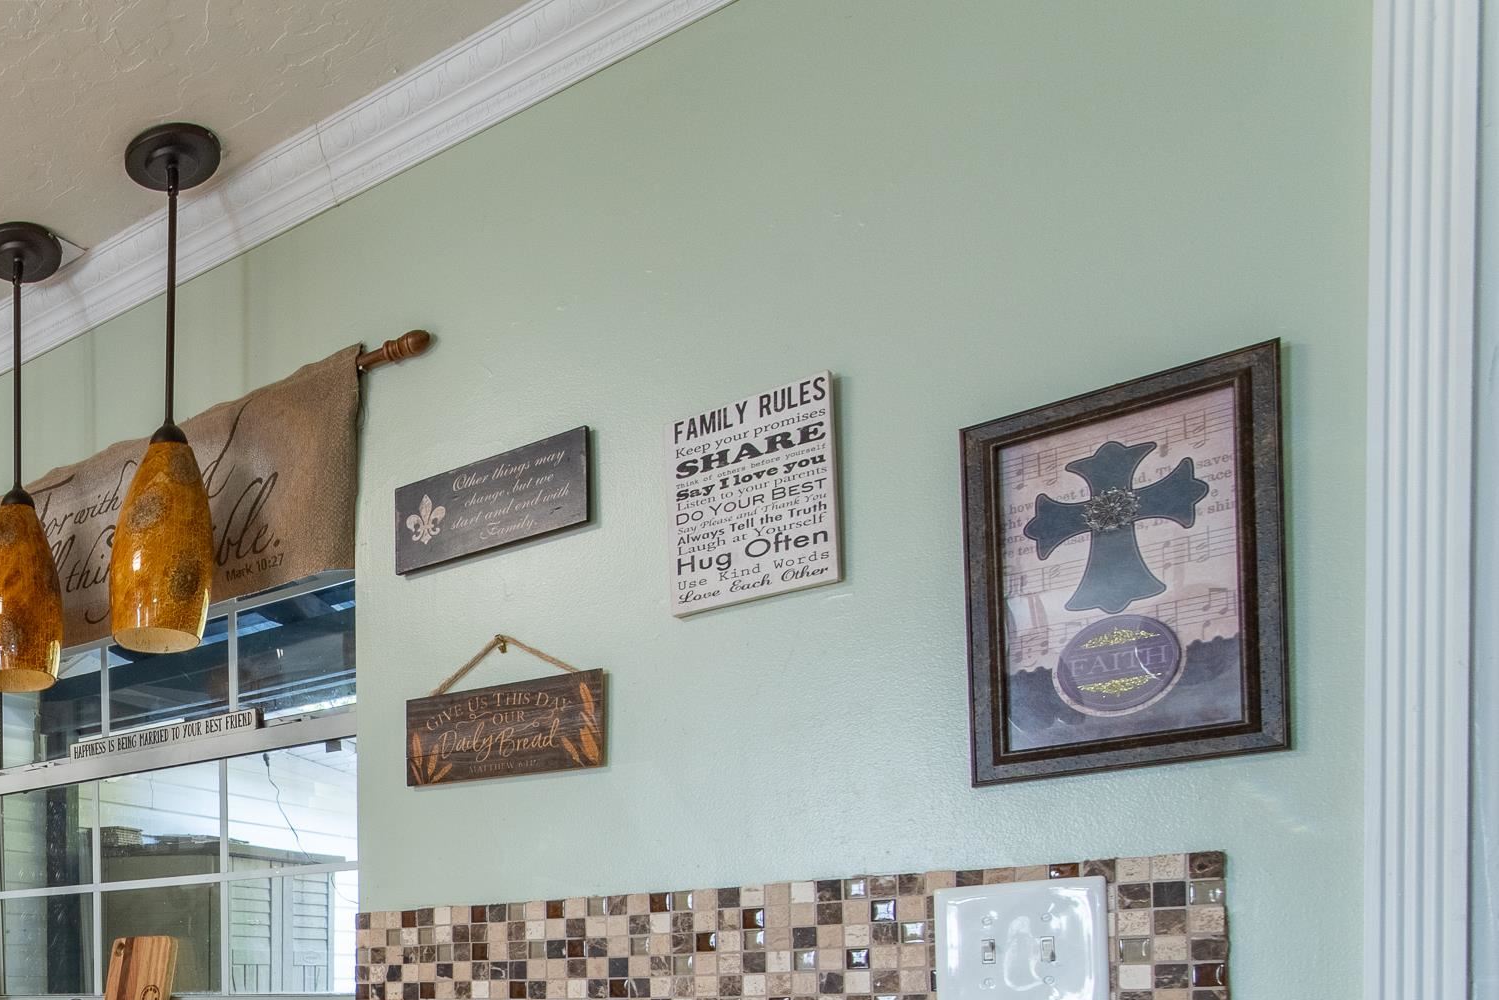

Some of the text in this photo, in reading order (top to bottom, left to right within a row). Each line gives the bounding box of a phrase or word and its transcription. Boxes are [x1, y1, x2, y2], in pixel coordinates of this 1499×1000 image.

[674, 376, 826, 444] FAMILY RULES
[675, 408, 826, 459] Keep your promises
[675, 421, 826, 480] SHARE
[452, 450, 565, 492] Other things may
[511, 477, 532, 494] but
[535, 473, 555, 485] we
[676, 443, 826, 490] Think of others before yourself
[676, 453, 826, 502] Say I love you
[677, 465, 828, 512] Listen to your parents
[451, 482, 570, 530] start and end with
[677, 492, 827, 535] Say Please and Thank You
[709, 493, 765, 516] YOUR
[771, 477, 827, 500] BEST
[677, 501, 827, 546] Always Tell the Truth
[677, 511, 827, 556] Laugh at Yourself
[226, 551, 285, 582] Mark 10:27
[677, 530, 828, 576] Hug Often
[677, 551, 830, 591] Use Kind Words
[677, 565, 829, 605] Love Each Other
[1069, 644, 1171, 677] FAITH
[426, 692, 573, 731] GIVE US THIS DAY
[492, 710, 526, 726] OUR
[73, 711, 253, 760] HAPPINESS IS BEING MARRIED TO YOUR BEST FRIEND
[439, 717, 560, 762] Daily Bread
